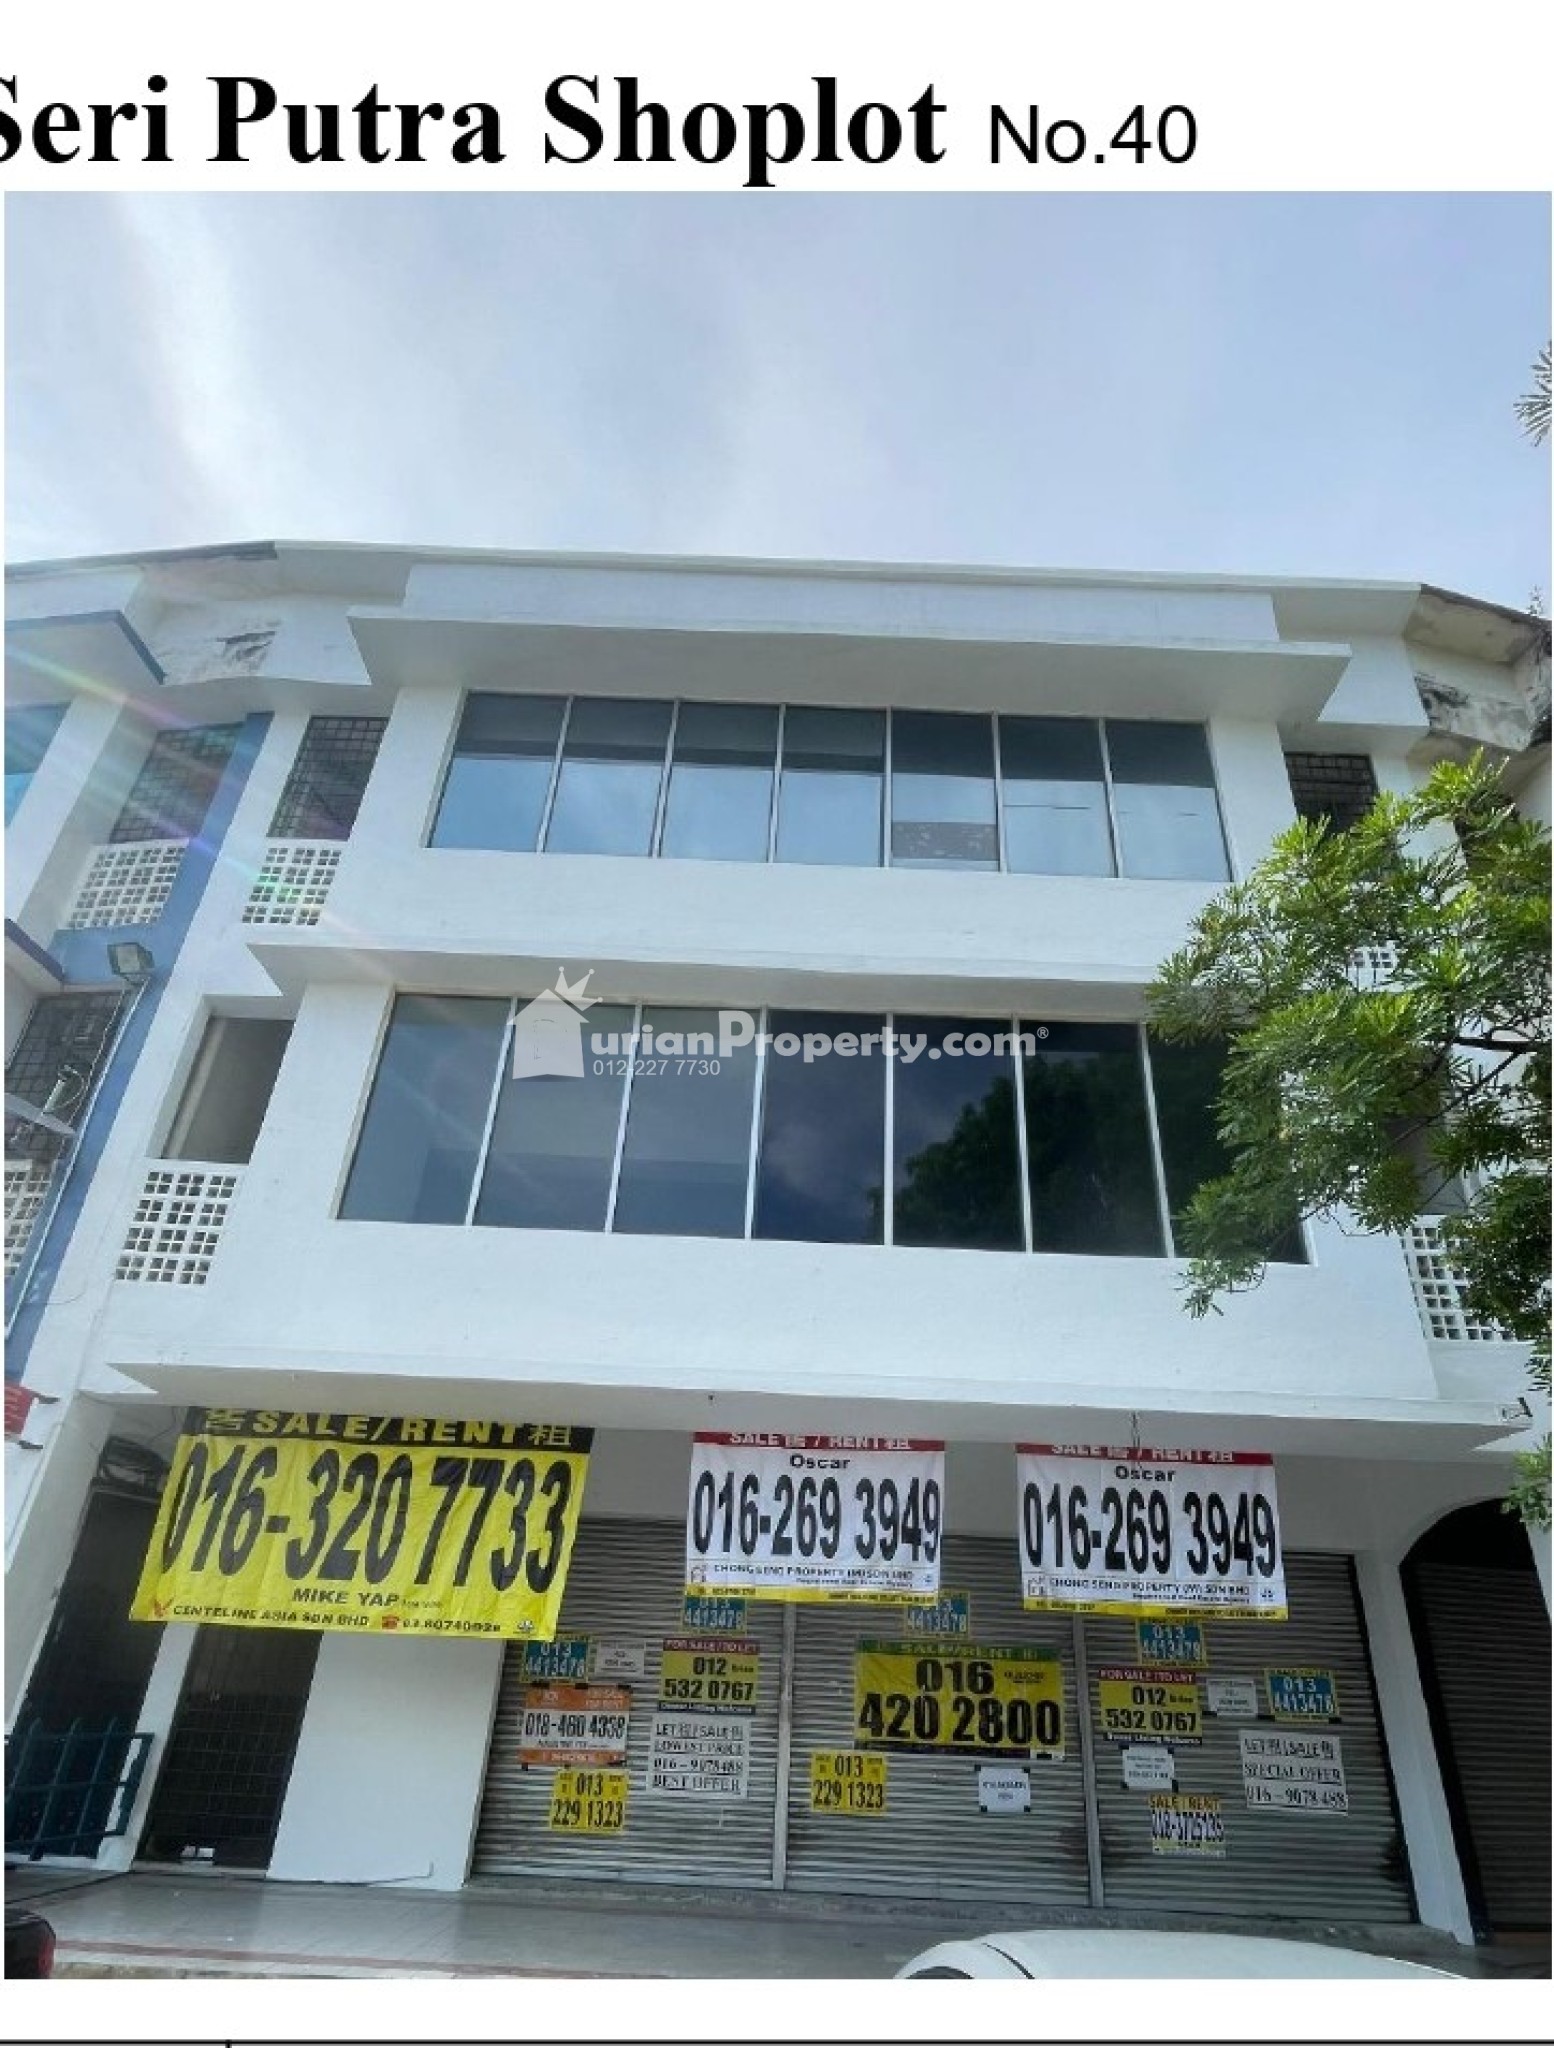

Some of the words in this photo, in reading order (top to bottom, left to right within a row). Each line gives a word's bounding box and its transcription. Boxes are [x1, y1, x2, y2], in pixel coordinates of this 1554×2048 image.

[789, 1453, 851, 1470] Oscar
[1114, 1465, 1176, 1482] Oscar
[161, 1442, 413, 1584] 016-320
[413, 1456, 572, 1593] 7733
[694, 1470, 841, 1560] 016-269
[854, 1476, 940, 1563] 3949
[1024, 1483, 1171, 1575] 016-269
[1182, 1491, 1277, 1579] 3949
[292, 1587, 348, 1607] MIKE
[358, 1592, 400, 1608] YAP
[693, 1656, 727, 1676] 012
[916, 1657, 996, 1695] 016
[663, 1678, 703, 1699] 532
[707, 1679, 754, 1701] 0767
[1132, 1685, 1167, 1707] 012
[859, 1692, 940, 1740] 420
[952, 1695, 1061, 1746] 2800
[1104, 1708, 1147, 1729] 532
[1149, 1710, 1197, 1732] 0767
[834, 1754, 864, 1778] 013
[575, 1772, 604, 1796] 013
[812, 1779, 843, 1806] 229
[846, 1781, 884, 1809] 1323
[551, 1798, 581, 1826] 229
[587, 1799, 623, 1828] 1323
